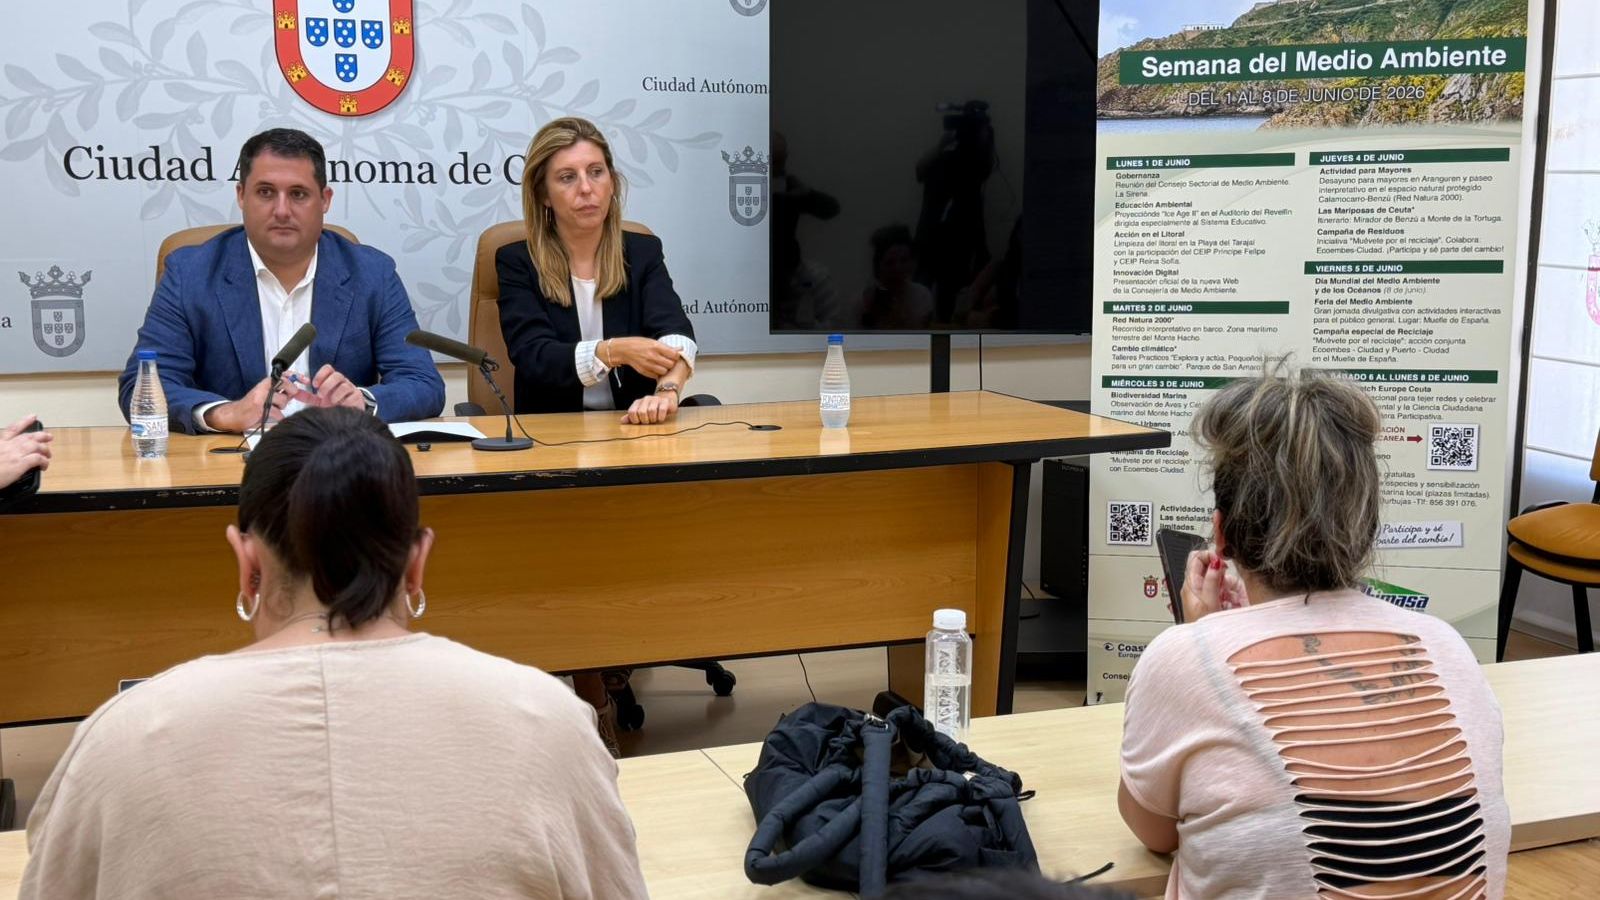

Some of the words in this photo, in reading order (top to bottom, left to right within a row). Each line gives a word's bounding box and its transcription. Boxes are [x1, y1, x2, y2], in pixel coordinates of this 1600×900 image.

[1141, 53, 1241, 78] Semana
[1249, 52, 1286, 75] del
[1296, 49, 1372, 73] Medio
[1382, 46, 1507, 70] Ambiente
[642, 76, 695, 92] Ciudad
[700, 78, 769, 94] Autónom
[1188, 92, 1219, 106] DEL
[1225, 92, 1232, 105] 1
[1237, 91, 1259, 105] AL
[1263, 90, 1271, 104] 8
[1276, 90, 1297, 104] DE
[1303, 88, 1353, 103] JUNIO
[1358, 87, 1381, 102] DE
[1387, 86, 1425, 101] 2026
[63, 145, 216, 182] Ciudad
[449, 151, 492, 185] de
[1152, 159, 1163, 167] DE
[1378, 167, 1411, 175] Mayores
[1158, 181, 1187, 189] Consejo
[1319, 177, 1356, 186] Desayuno
[1422, 176, 1461, 184] Aranguren
[1334, 207, 1374, 215] Mariposas
[1115, 220, 1139, 228] dirigida
[1142, 219, 1190, 228] especialmente
[1317, 228, 1354, 237] Campaña
[1156, 269, 1179, 277] Digital
[703, 299, 769, 314] Autónom
[1147, 326, 1191, 334] interpretativo
[1313, 328, 1349, 336] Campaña
[1379, 386, 1406, 394] Europe
[1160, 505, 1205, 513] Actividades
